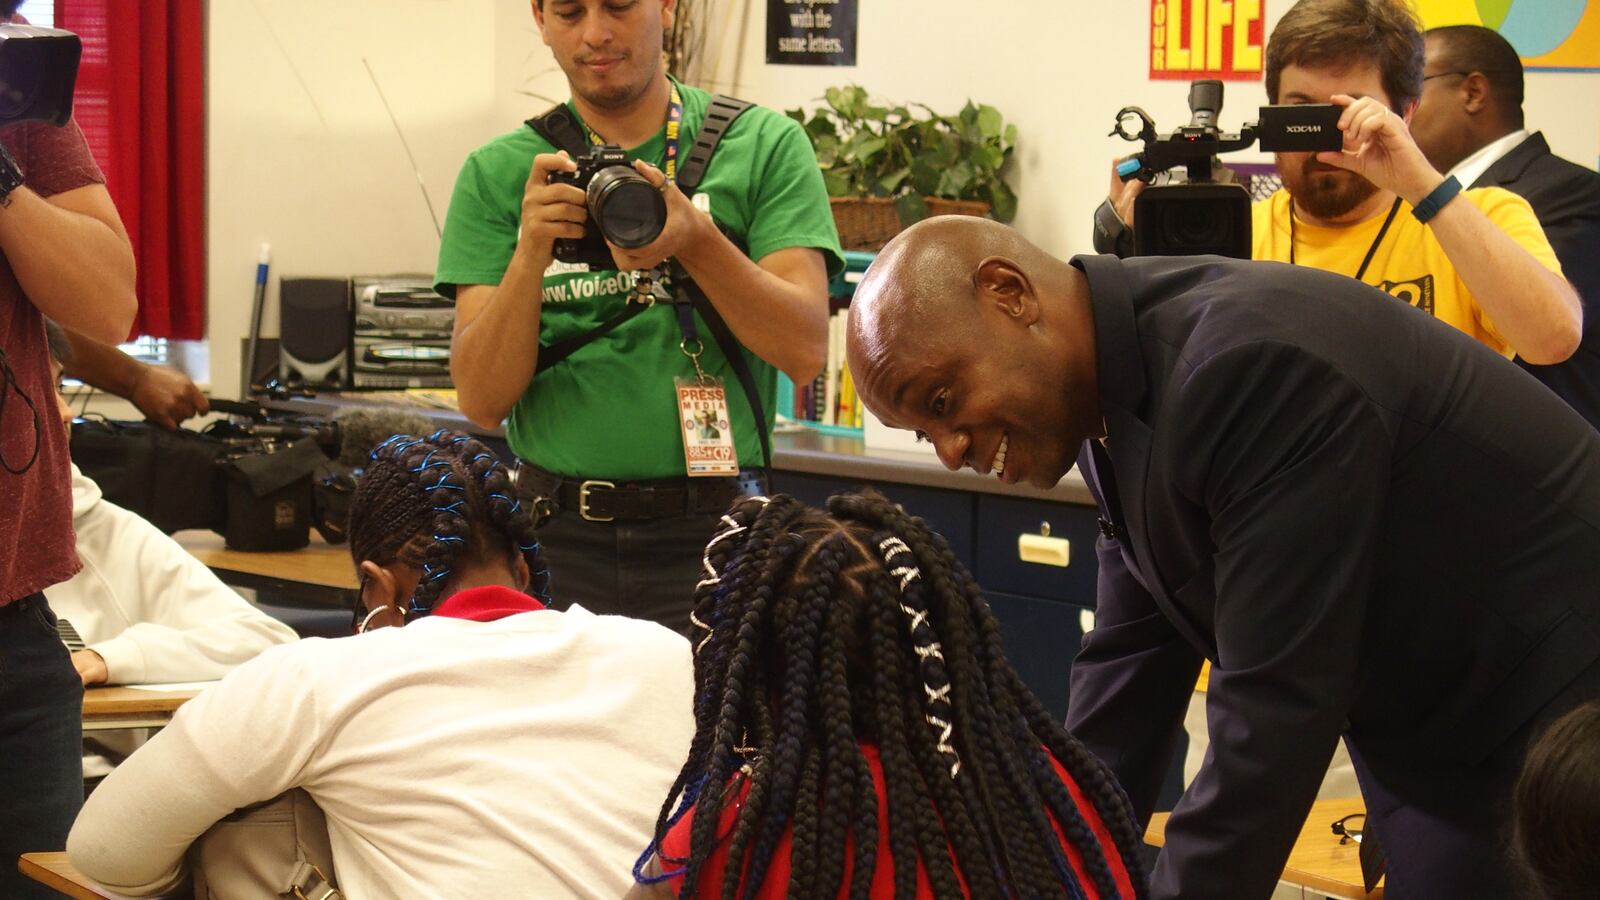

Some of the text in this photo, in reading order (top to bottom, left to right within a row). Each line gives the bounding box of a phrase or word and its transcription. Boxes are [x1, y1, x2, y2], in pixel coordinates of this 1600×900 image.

[790, 7, 833, 28] with the
[779, 32, 844, 53] same letters.
[1152, 0, 1166, 71] OUR
[1165, 0, 1262, 72] LIFE
[1286, 125, 1321, 133] XDCAM
[681, 389, 724, 401] PRESS
[682, 401, 725, 410] MEDIA
